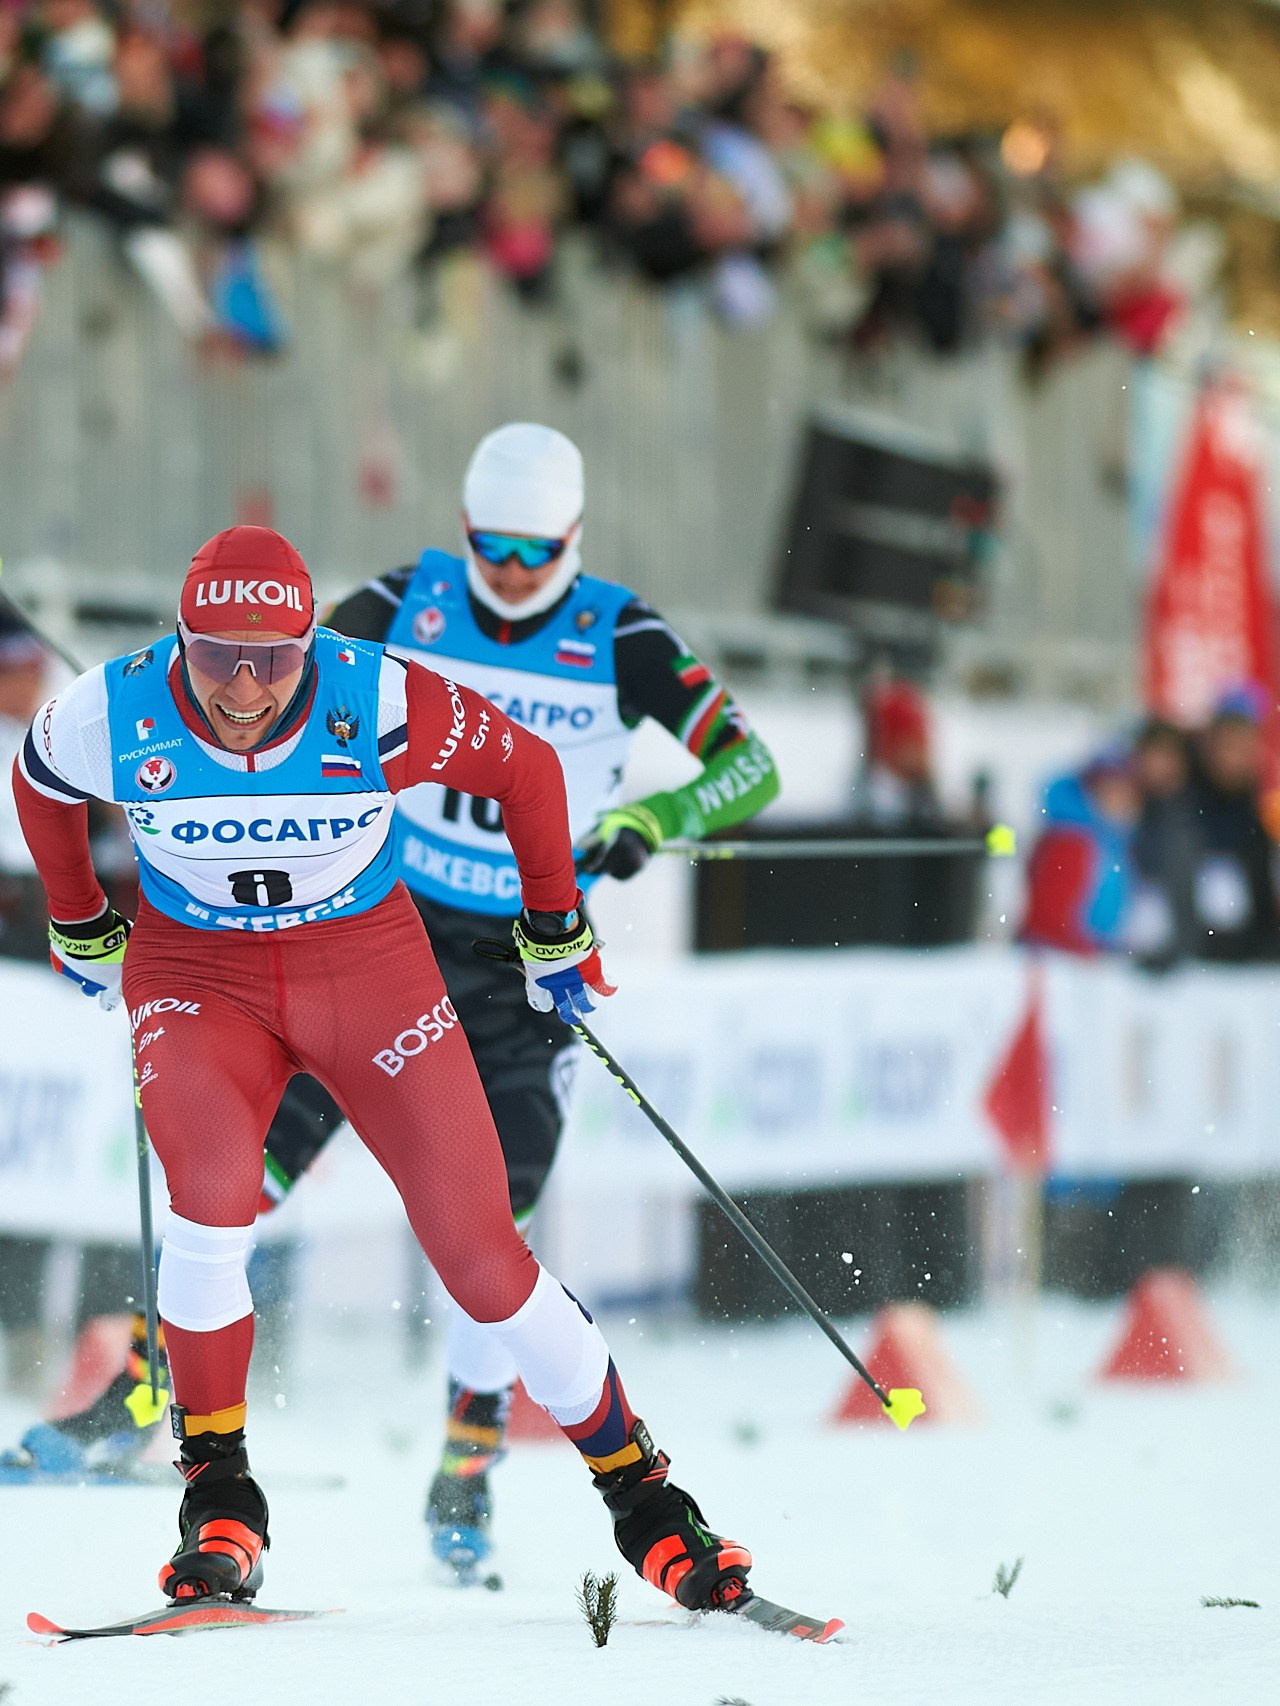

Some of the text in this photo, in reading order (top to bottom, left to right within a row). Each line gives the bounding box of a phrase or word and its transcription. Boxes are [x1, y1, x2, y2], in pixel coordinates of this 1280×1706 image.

[196, 579, 303, 612] LUKOIL
[119, 738, 183, 763] РУСКЛИМАТ
[171, 806, 383, 844] ФОСАГРО
[403, 834, 523, 900] ИЖЕВС
[131, 998, 202, 1034] UKOIL
[372, 995, 458, 1078] BOSCO
